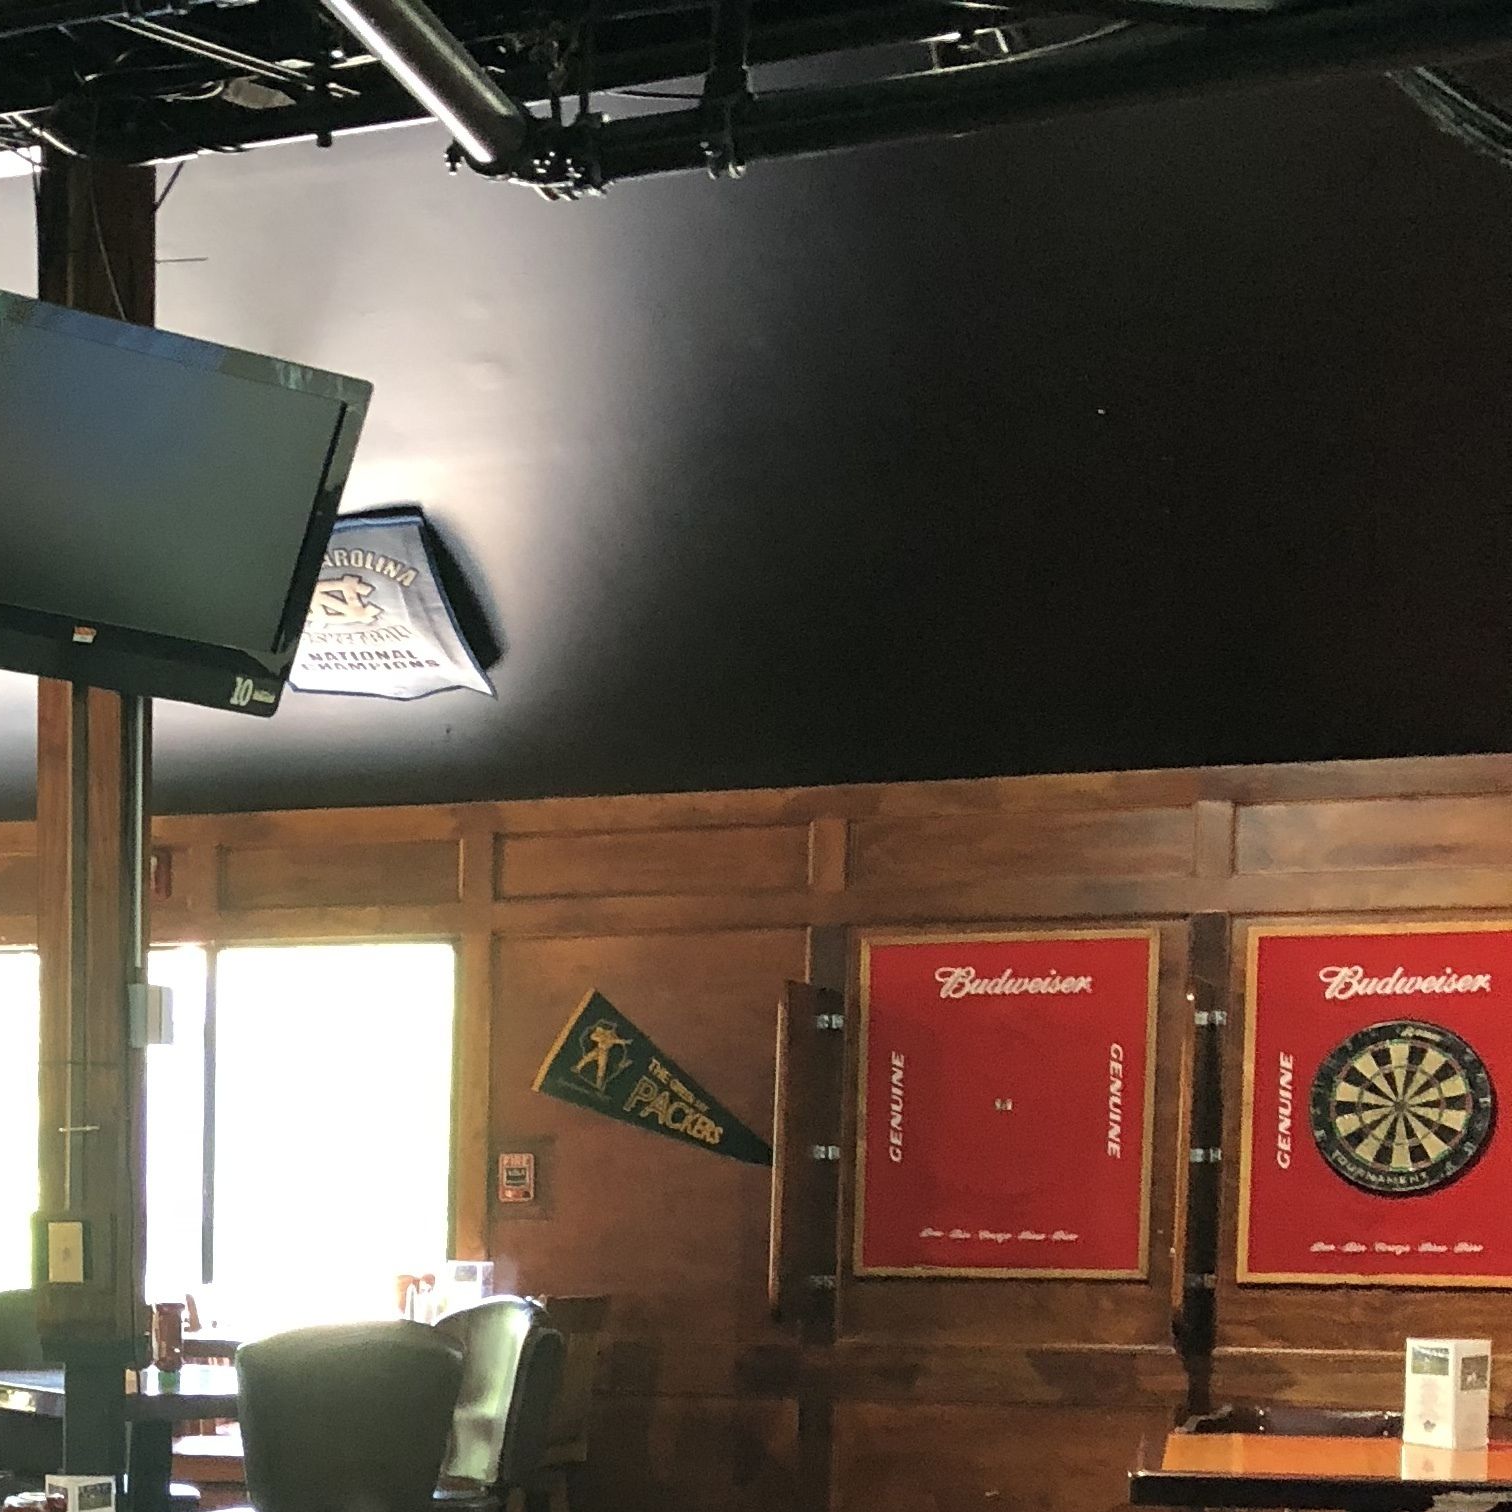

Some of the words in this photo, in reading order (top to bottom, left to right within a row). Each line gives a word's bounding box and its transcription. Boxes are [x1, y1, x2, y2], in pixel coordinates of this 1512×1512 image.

[321, 547, 419, 588] AROLINA
[307, 649, 418, 662] NATIONAL
[934, 965, 1094, 999] Budweiser
[1318, 964, 1492, 1000] Budweiser
[622, 1074, 724, 1146] PACKERS
[888, 1050, 905, 1163] GENUINE
[1106, 1042, 1124, 1160] GENUINE
[1276, 1050, 1294, 1170] GENUINE
